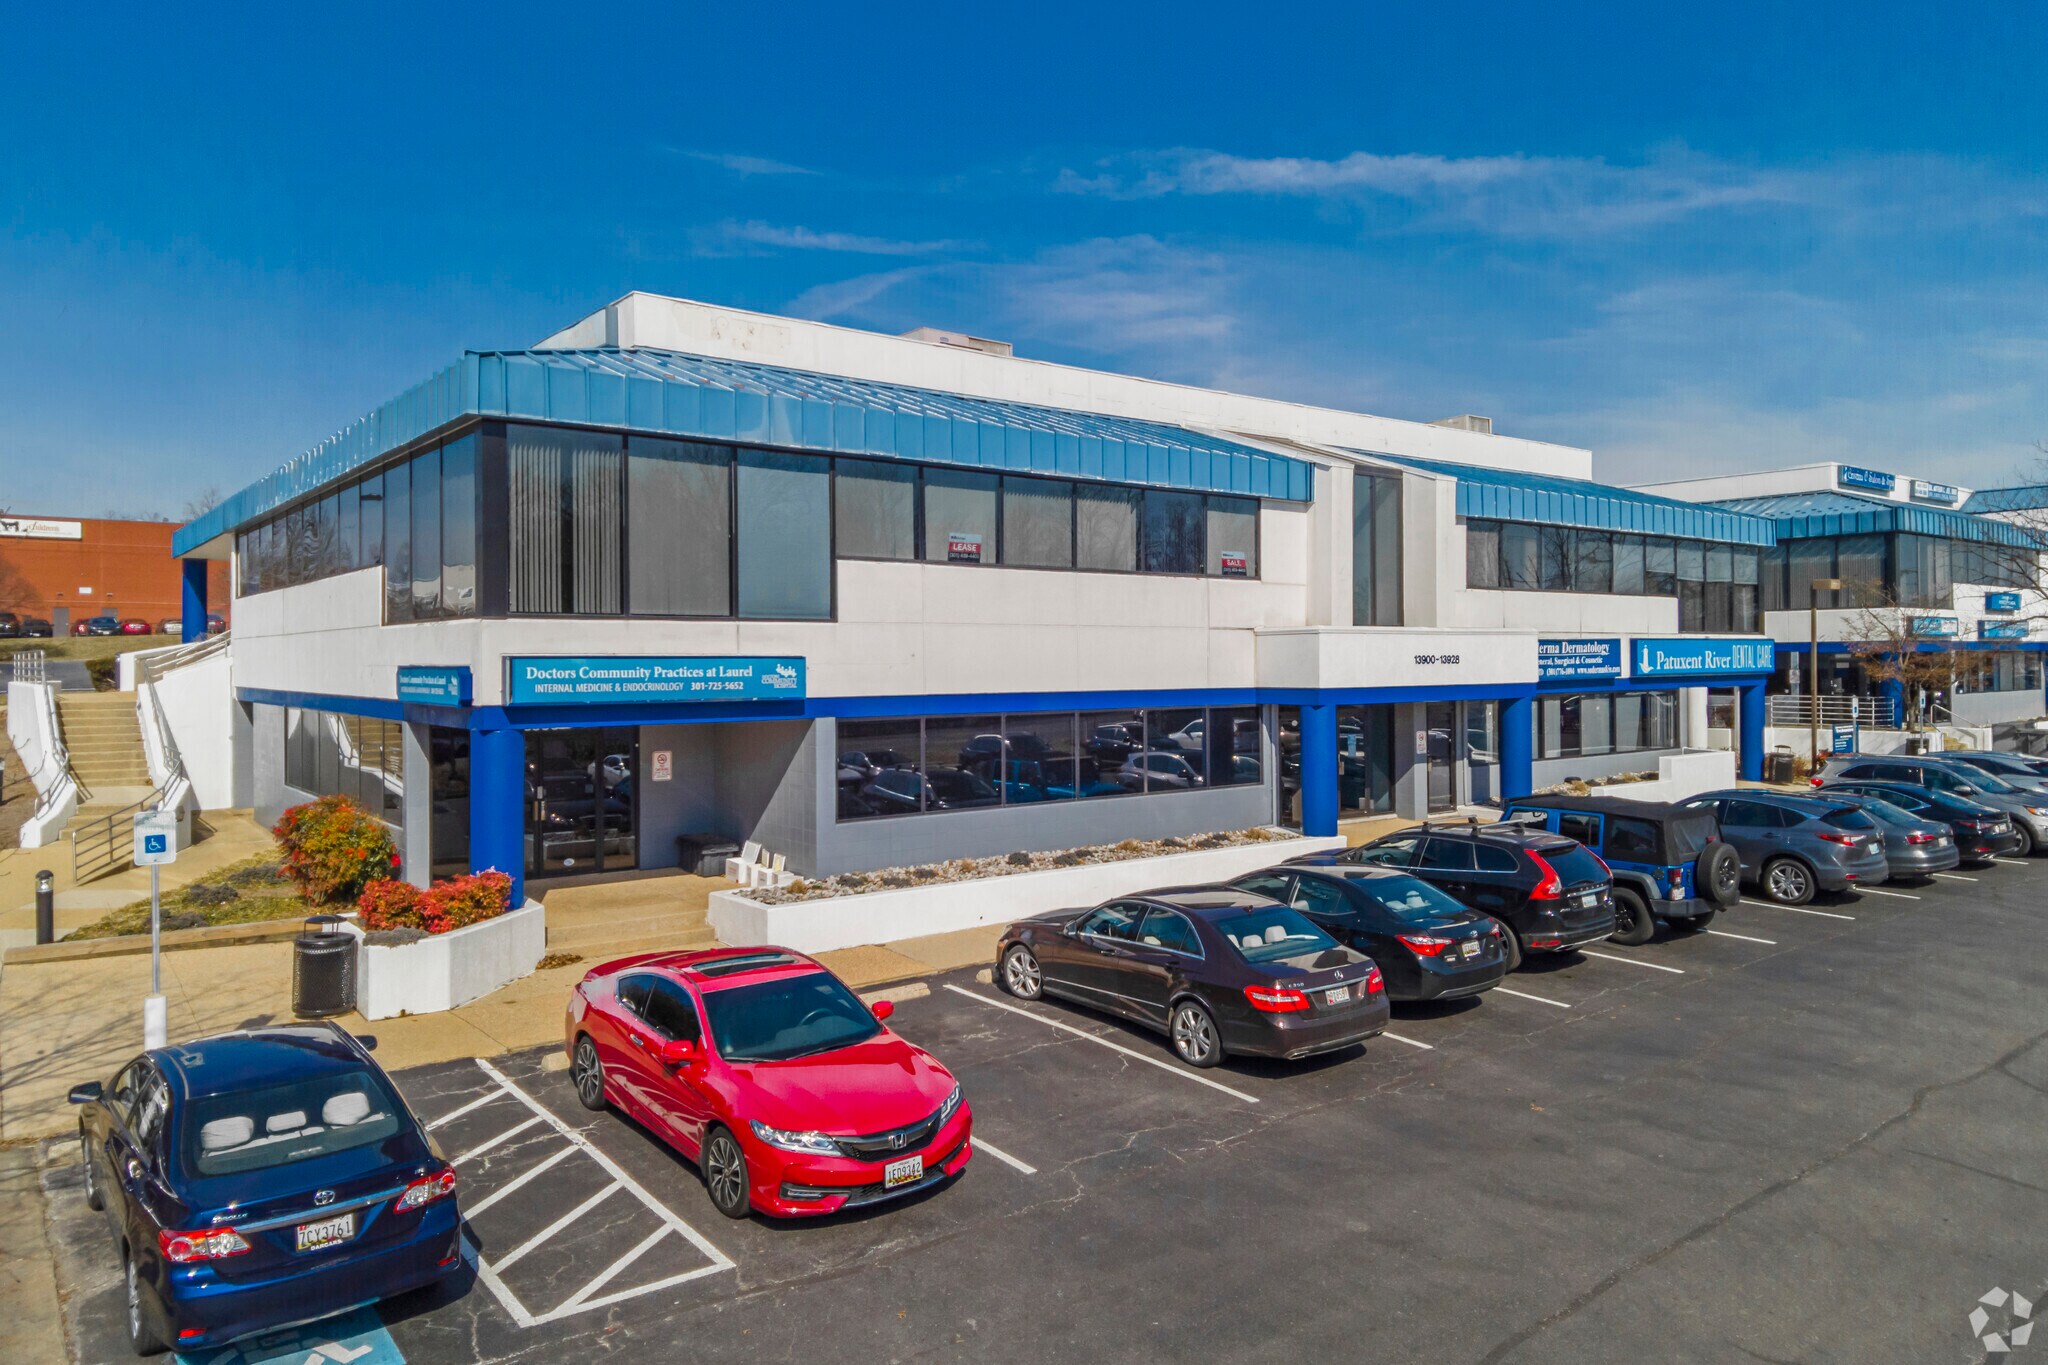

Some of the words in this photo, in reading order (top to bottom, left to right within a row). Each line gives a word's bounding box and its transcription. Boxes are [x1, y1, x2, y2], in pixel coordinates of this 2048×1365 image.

[953, 543, 977, 552] LEASE
[1227, 559, 1242, 567] SALE
[1537, 643, 1559, 654] erma
[1562, 641, 1610, 656] Dermatology
[1414, 654, 1460, 665] 13900-13928
[1581, 655, 1603, 665] Cosmetic
[1656, 650, 1702, 670] Patuxent
[1705, 650, 1731, 669] River
[1732, 644, 1755, 669] DENTAL
[1757, 644, 1772, 669] CARE
[526, 666, 577, 679] Doctors
[579, 666, 651, 681] Community
[653, 666, 704, 678] Practices
[706, 667, 717, 678] at
[719, 665, 753, 677] Laurel
[534, 684, 574, 693] INTERNAL
[575, 683, 613, 692] MEDICINE
[614, 683, 622, 692] &
[622, 682, 684, 692] ENDOCRINOLOGY
[690, 681, 744, 691] 301-725-5652
[299, 1220, 350, 1247] 7CY3761
